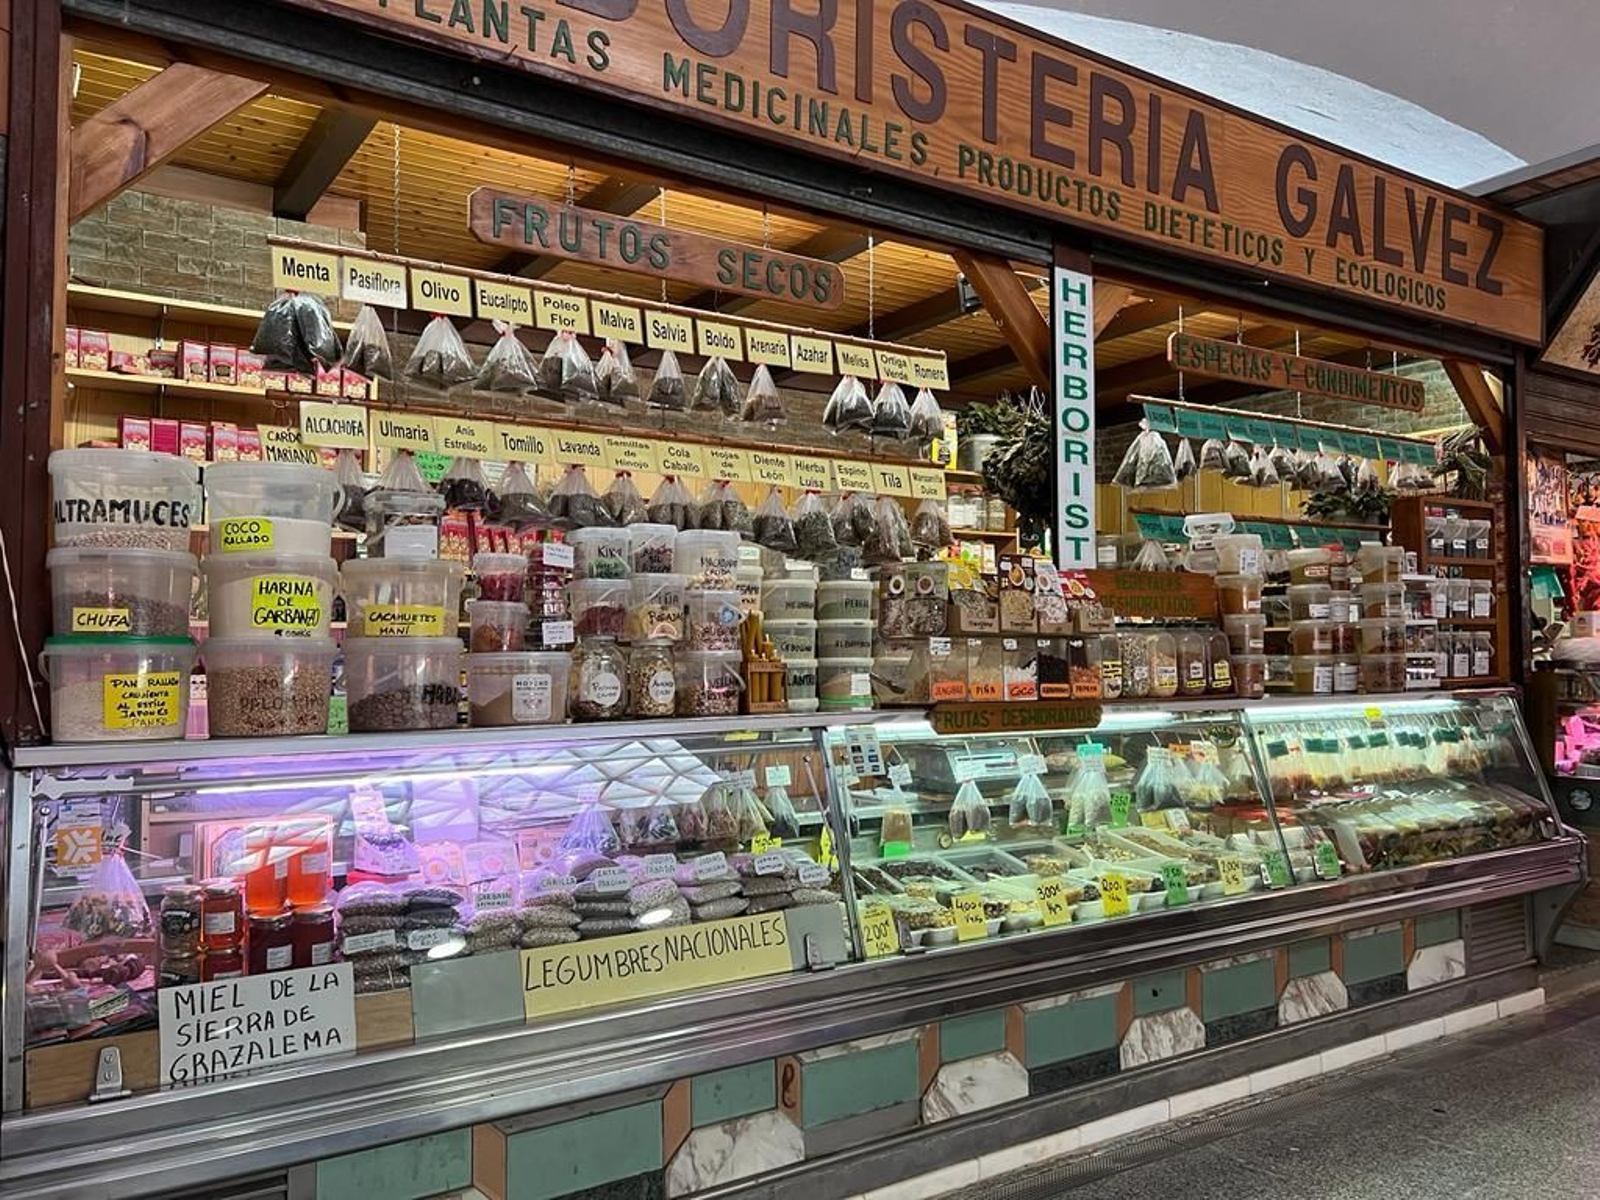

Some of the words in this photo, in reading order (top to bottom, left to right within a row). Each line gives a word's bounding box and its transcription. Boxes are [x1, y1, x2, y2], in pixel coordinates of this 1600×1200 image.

[378, 0, 611, 72] LANTAS
[958, 144, 1121, 221] PRODUCTOS
[1144, 201, 1283, 266] DIETETICOS
[1305, 247, 1317, 275] Y
[1336, 258, 1446, 311] ECOLOGICOS
[1275, 143, 1505, 297] GALVEZ
[493, 199, 670, 270] FRUTOS
[717, 248, 832, 303] SECOS
[281, 256, 330, 281] Menta
[349, 267, 401, 294] Pasiflora
[420, 280, 460, 302] Olivo
[480, 289, 529, 314] Eucalipto
[542, 295, 580, 312] Poleo
[550, 313, 576, 327] Flor
[599, 309, 635, 331] Malva
[652, 319, 687, 343] Salvia
[705, 329, 735, 349] Boldo
[796, 344, 828, 364] Azahar
[1174, 334, 1272, 381] ESPECIAS
[1303, 364, 1424, 410] CONDIMENTOS
[305, 416, 364, 437] ALCACHOFA
[1061, 276, 1091, 562] HERBORIST
[379, 420, 429, 442] Ulmaria
[501, 432, 544, 454] Tomillo
[558, 438, 600, 456] Lavanda
[668, 446, 690, 459] Cola
[880, 472, 902, 489] Tila
[224, 521, 260, 535] COCO
[259, 580, 313, 597] HARINA
[277, 596, 294, 606] DE
[77, 612, 131, 628] CHUFA
[975, 683, 996, 694] PIÑA
[524, 943, 664, 992] LEGUMBRES
[664, 916, 787, 965] NACIONALES
[173, 982, 246, 1020] MIEL
[270, 976, 296, 1001] DE
[308, 971, 340, 993] LA
[176, 1010, 275, 1048] SIERRA
[283, 1005, 316, 1027] DE
[169, 1027, 342, 1083] GRAZALEMA
